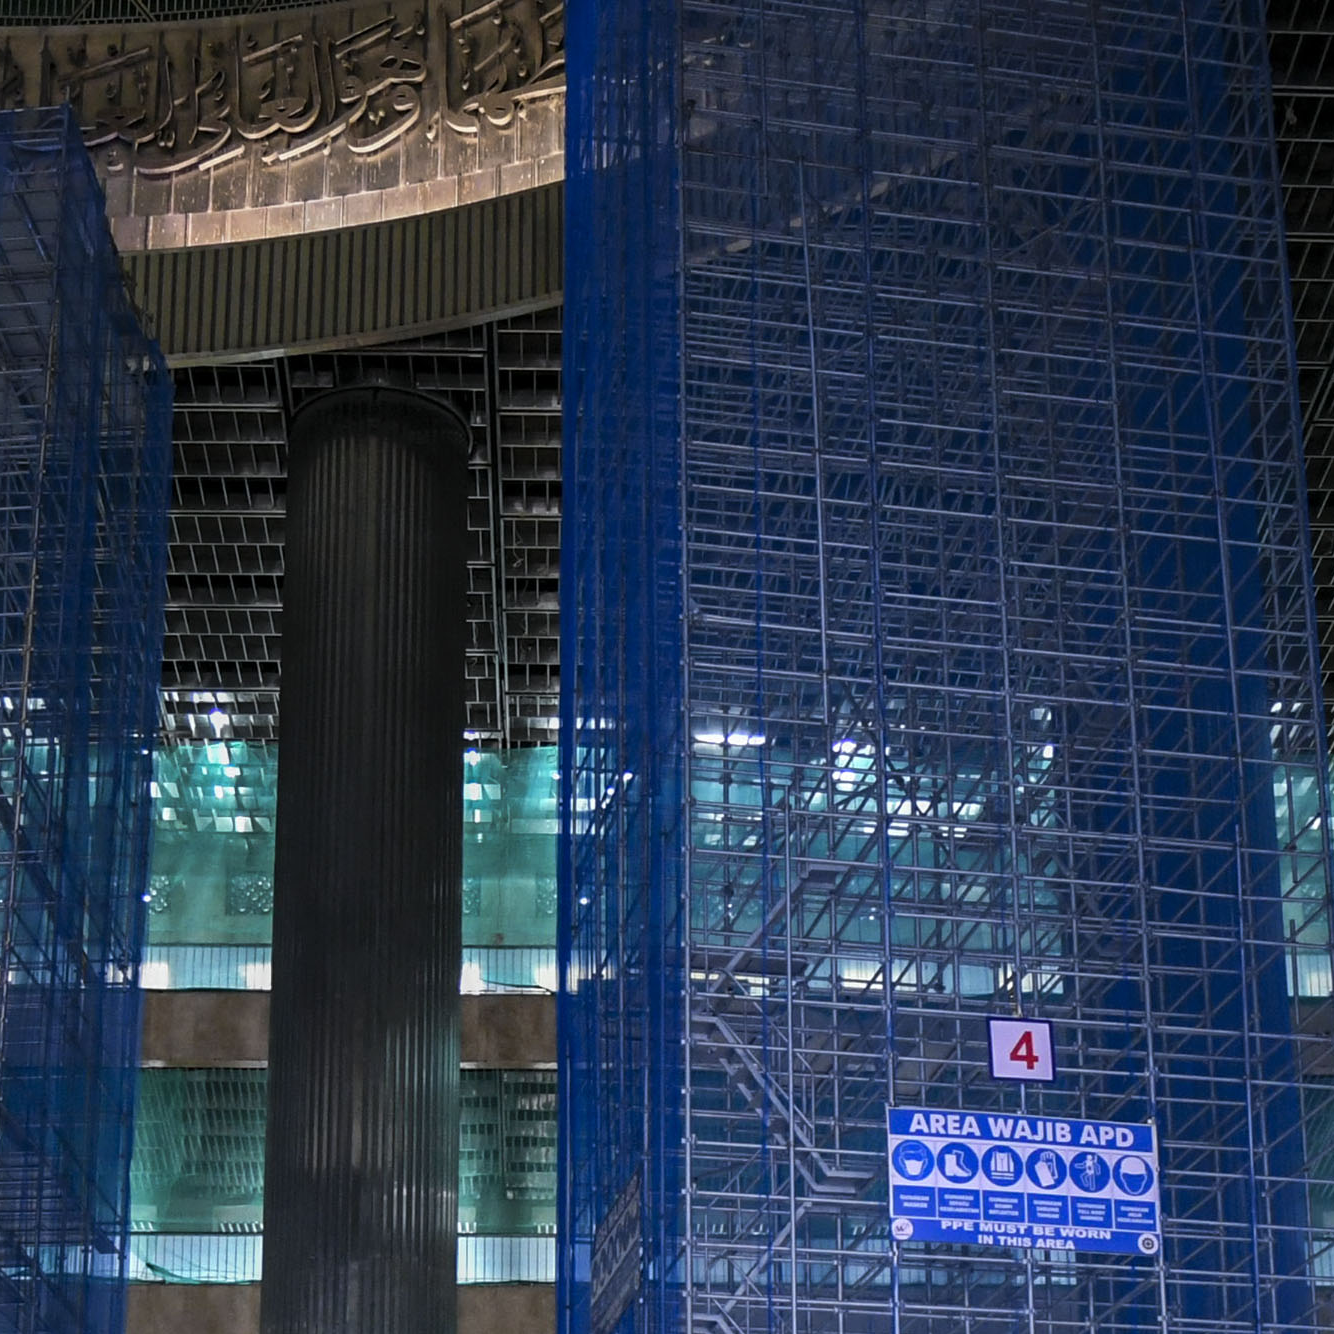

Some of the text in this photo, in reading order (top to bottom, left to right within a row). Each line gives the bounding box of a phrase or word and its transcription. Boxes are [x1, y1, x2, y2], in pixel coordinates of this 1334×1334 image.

[1009, 1030, 1039, 1070] 4
[909, 1111, 1135, 1149] AREA WAJIB APD
[940, 1220, 1112, 1241] PPE MUST BE WORN
[977, 1234, 1076, 1250] IN THIS AREA
